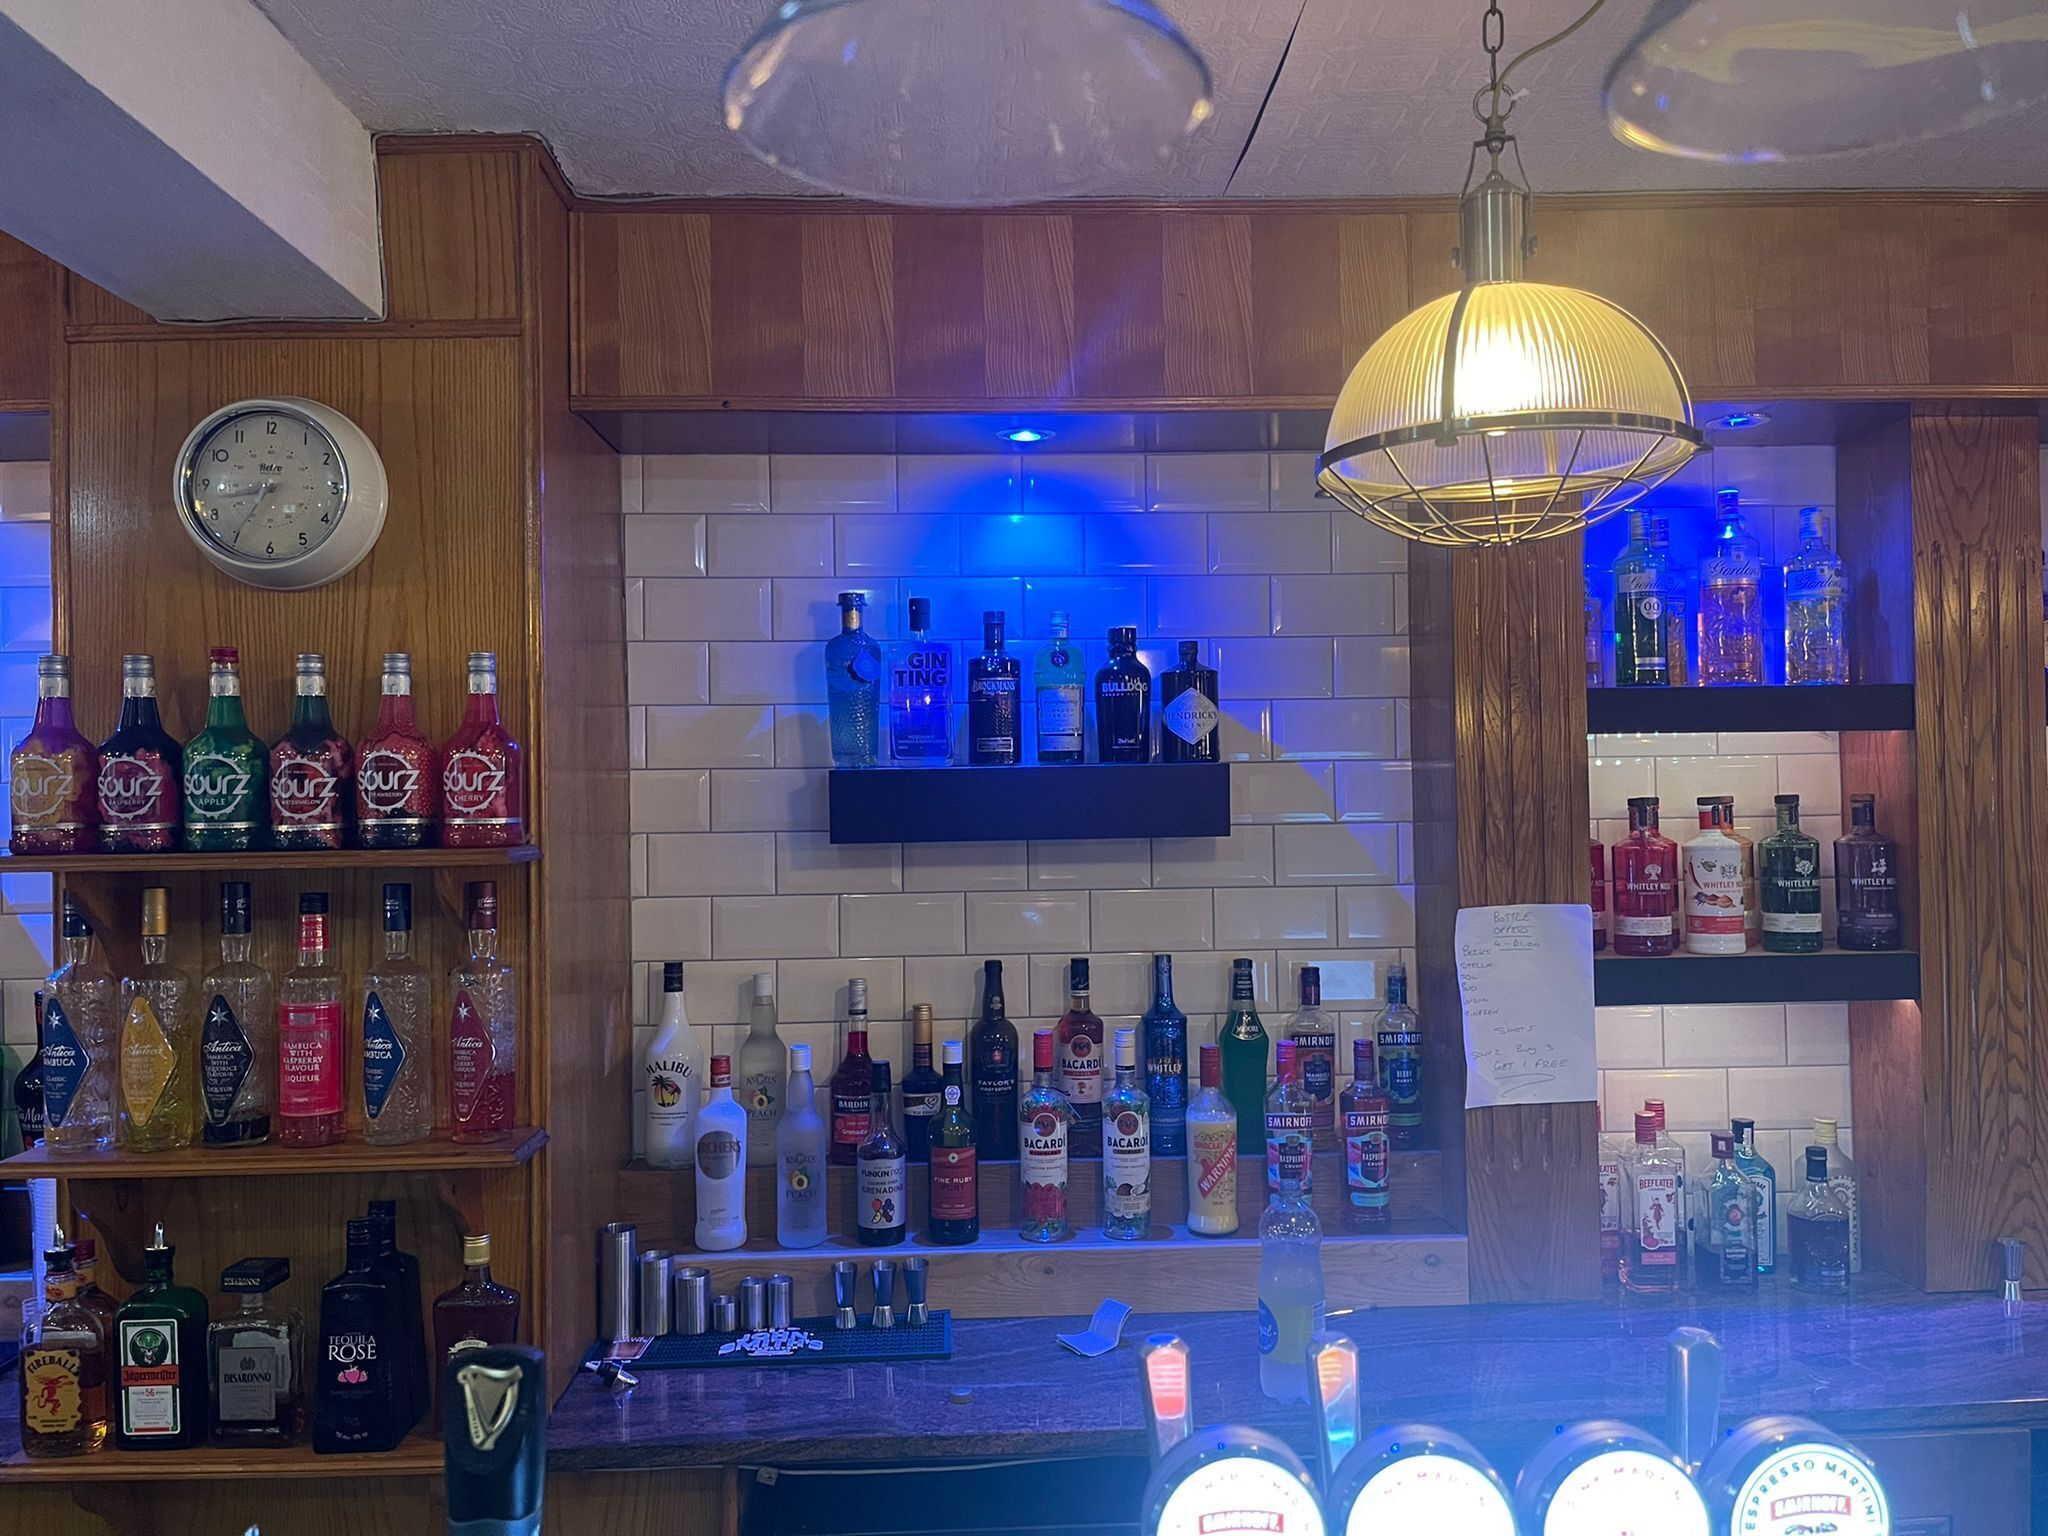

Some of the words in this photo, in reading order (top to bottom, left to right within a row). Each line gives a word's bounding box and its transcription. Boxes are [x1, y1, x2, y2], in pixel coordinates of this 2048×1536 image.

[266, 421, 277, 435] 12
[235, 430, 244, 443] 11
[212, 449, 228, 462] 10
[322, 453, 330, 466] 2
[202, 478, 210, 492] 9
[330, 482, 340, 495] 3
[210, 508, 219, 521] 8
[320, 512, 330, 524] 4
[298, 532, 308, 546] 5
[266, 542, 274, 554] 6
[908, 652, 947, 670] GIN
[894, 670, 947, 687] TING
[972, 680, 1016, 693] BROCKMANS
[1102, 682, 1148, 692] BULLDOG
[198, 798, 226, 806] APPLE
[454, 794, 484, 803] CHERRY
[1626, 882, 1658, 891] WHITLEY
[1702, 880, 1736, 890] WHITLEY
[1777, 880, 1811, 888] WHITLEY
[1851, 878, 1886, 887] WHITLEY
[1494, 912, 1534, 924] BOTTLE
[1493, 925, 1534, 935] OFFERS
[1494, 1025, 1536, 1035] SHOTS
[203, 1040, 242, 1053] Antica
[284, 1042, 322, 1050] SAMBUCA
[452, 1036, 483, 1048] Antica
[284, 1064, 320, 1072] FLAVOUR
[1494, 1060, 1514, 1072] GET
[1535, 1058, 1569, 1068] FREE
[838, 1100, 869, 1110] BARDIN
[747, 1108, 776, 1118] PEACH
[860, 1168, 890, 1178] FUNKIN
[1600, 1164, 1618, 1174] EATER
[1640, 1178, 1674, 1190] BEEFEATER
[328, 1334, 376, 1345] TEQUILA
[328, 1344, 377, 1363] ROSE
[224, 1372, 272, 1384] DISARONNO
[145, 1388, 155, 1398] 56
[1746, 1460, 1815, 1531] ESPRESSO
[1825, 1461, 1876, 1524] MARTINI
